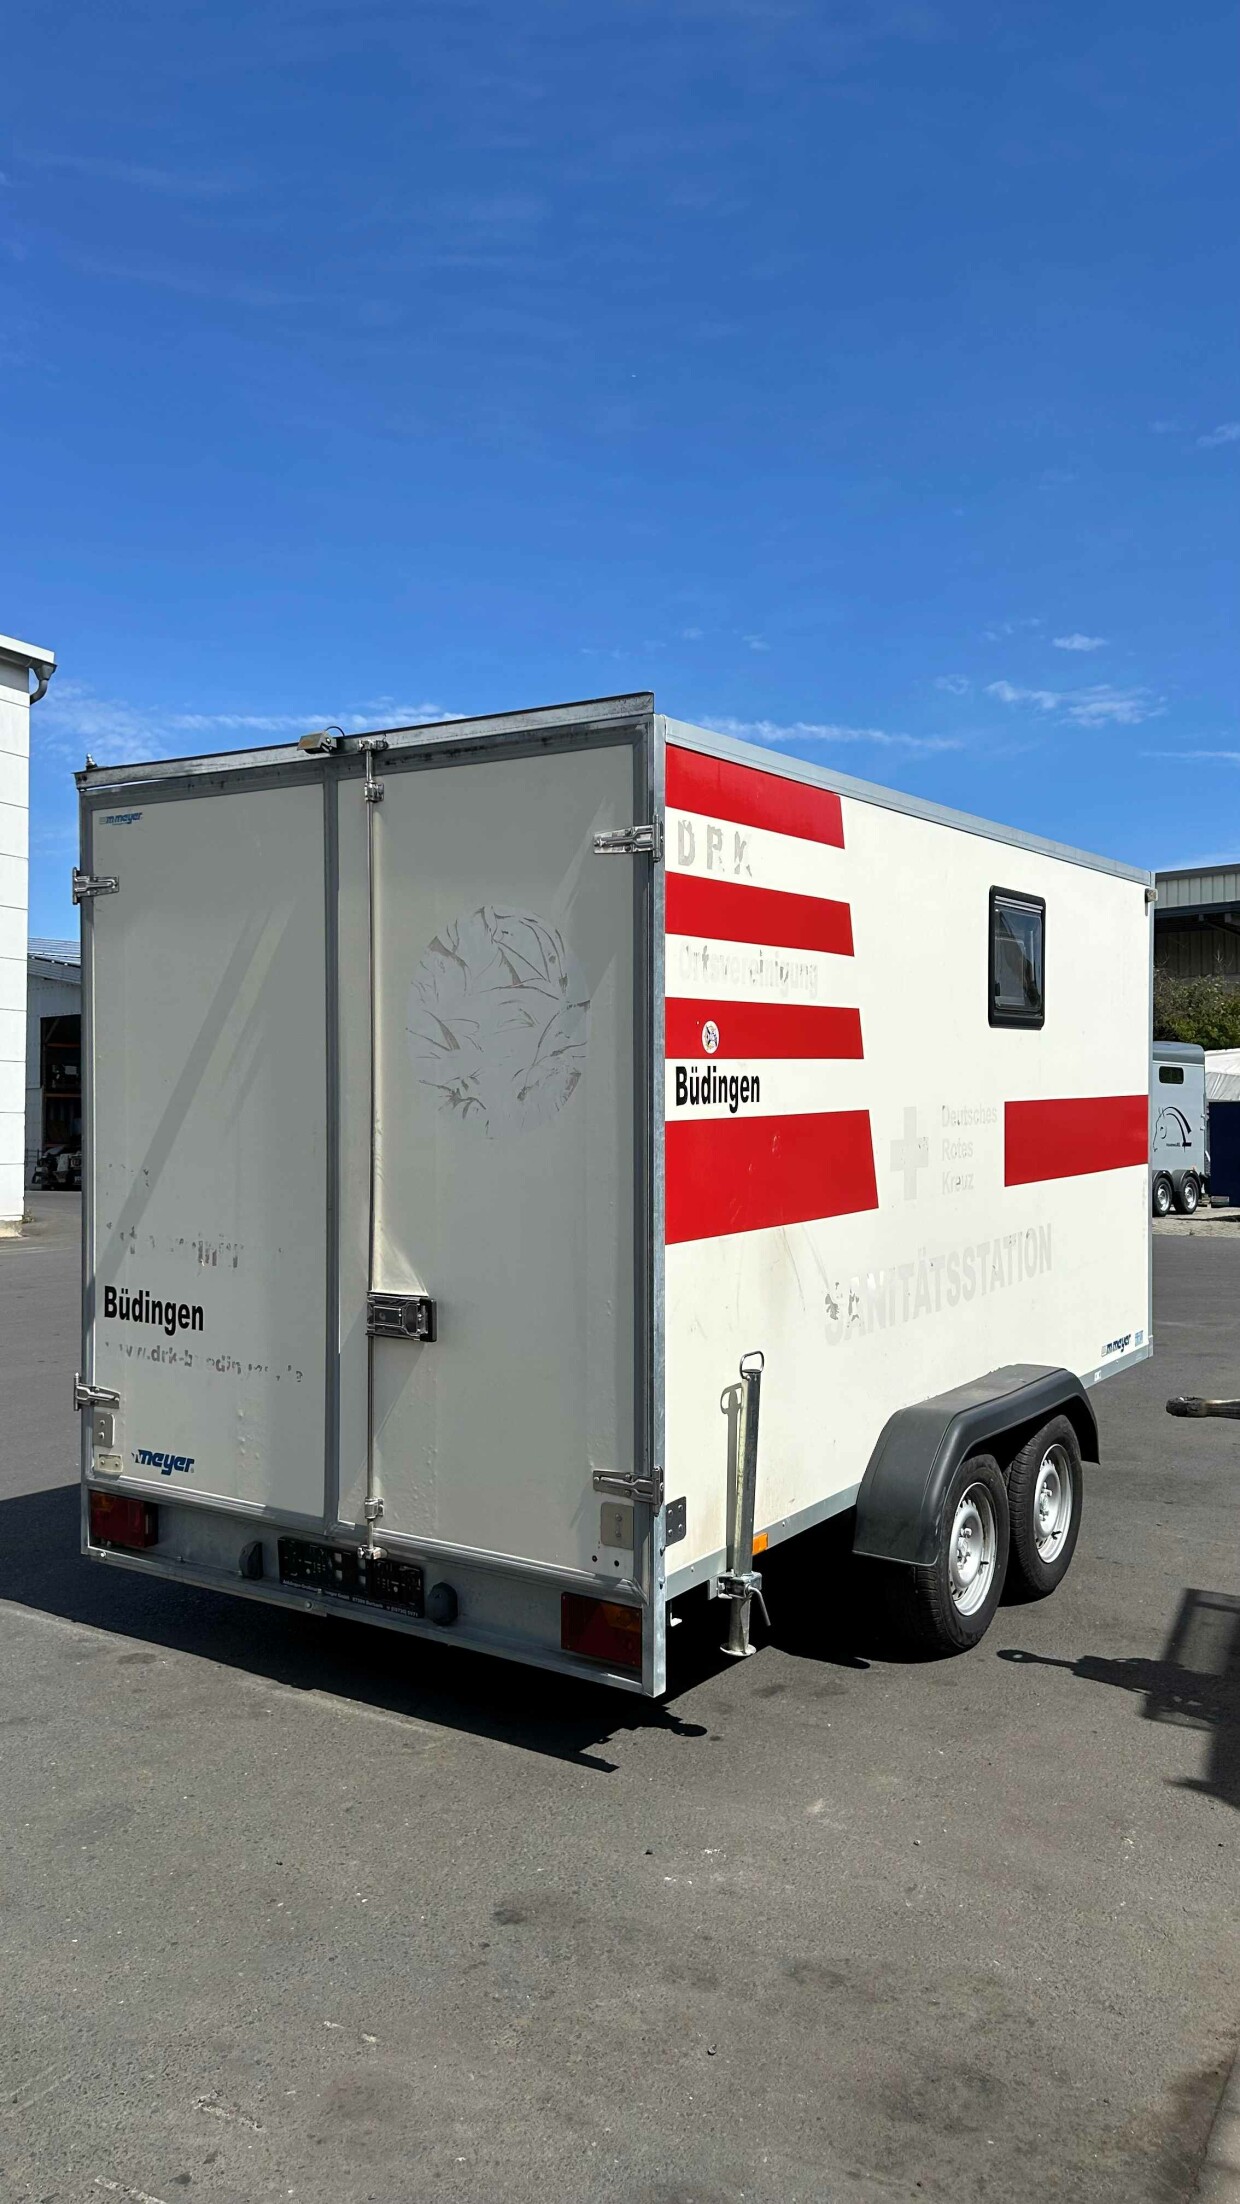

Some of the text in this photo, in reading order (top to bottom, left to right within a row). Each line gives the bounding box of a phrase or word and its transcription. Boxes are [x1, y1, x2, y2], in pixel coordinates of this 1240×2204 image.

[675, 1065, 761, 1114] Büdingen
[941, 1103, 998, 1128] Deutsches
[941, 1138, 974, 1161] Rotes
[941, 1171, 975, 1195] Kreuz
[825, 1223, 1053, 1346] SANITÄTSSTATION
[104, 1285, 204, 1336] Büdingen
